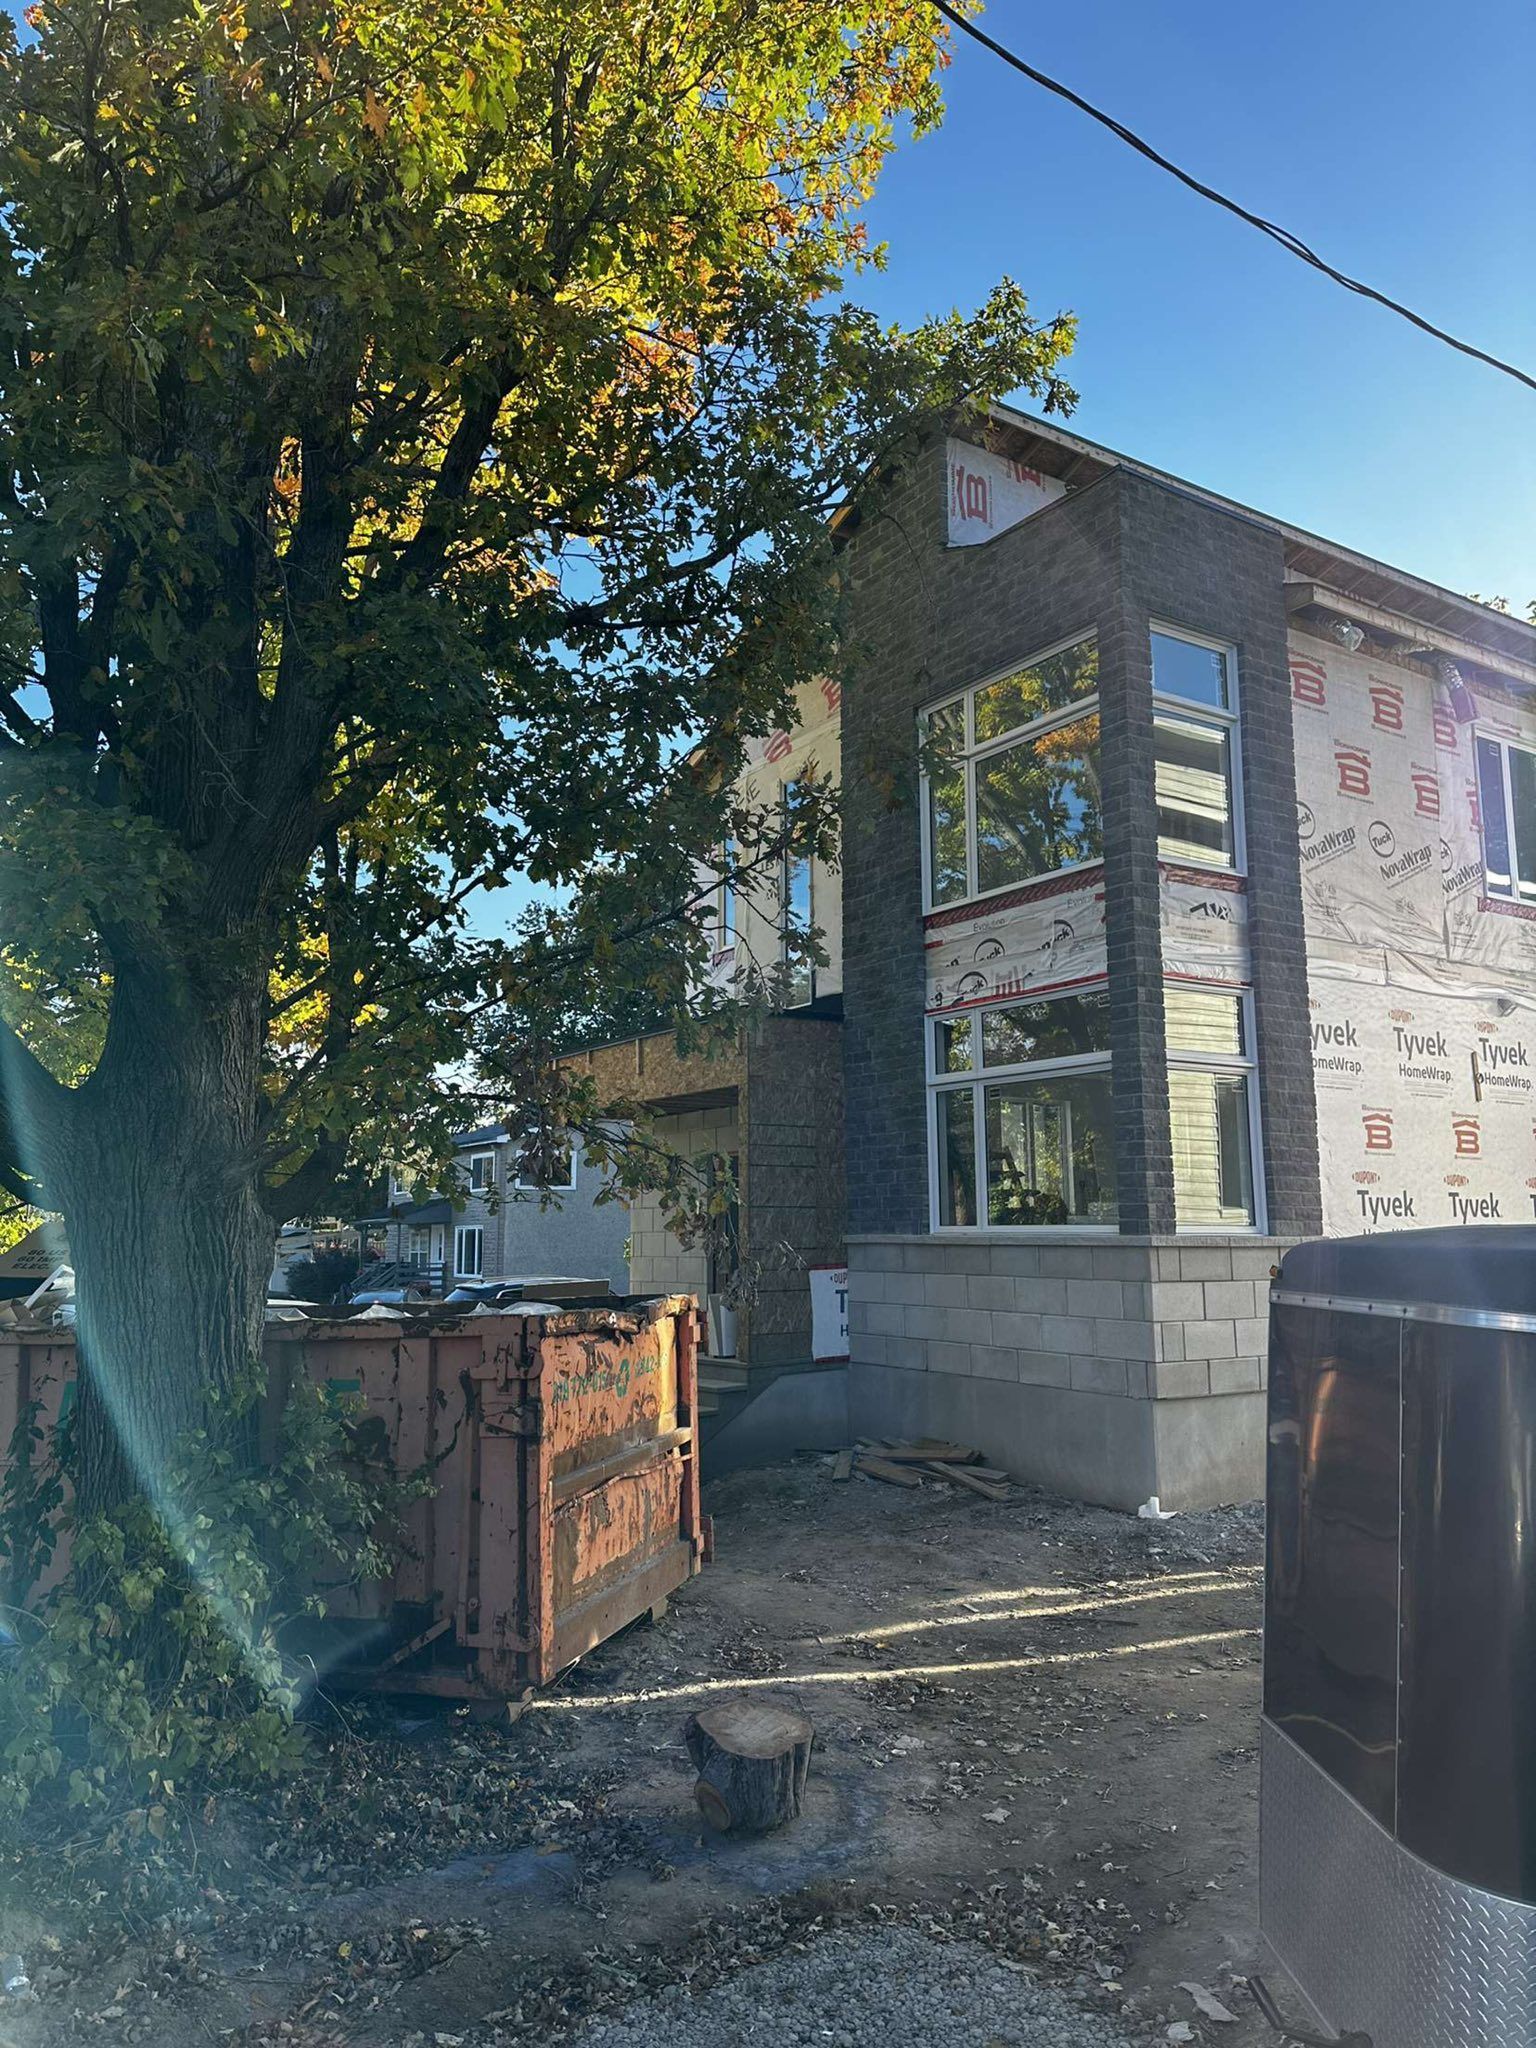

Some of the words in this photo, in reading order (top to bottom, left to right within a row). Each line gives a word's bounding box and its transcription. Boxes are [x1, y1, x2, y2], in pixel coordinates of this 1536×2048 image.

[1300, 826, 1356, 863] NovaWrap
[1371, 831, 1392, 847] Tuck
[1380, 845, 1432, 881] NovaWrap
[1311, 1020, 1357, 1050] yvek
[1392, 1026, 1448, 1060] Tyvek
[1312, 1056, 1362, 1075] omeWrap
[1478, 1037, 1528, 1069] Tyvek
[1365, 1124, 1393, 1150] B
[1455, 1130, 1480, 1153] B
[1357, 1190, 1415, 1224] Tyvek
[1448, 1192, 1500, 1224] Tyvek
